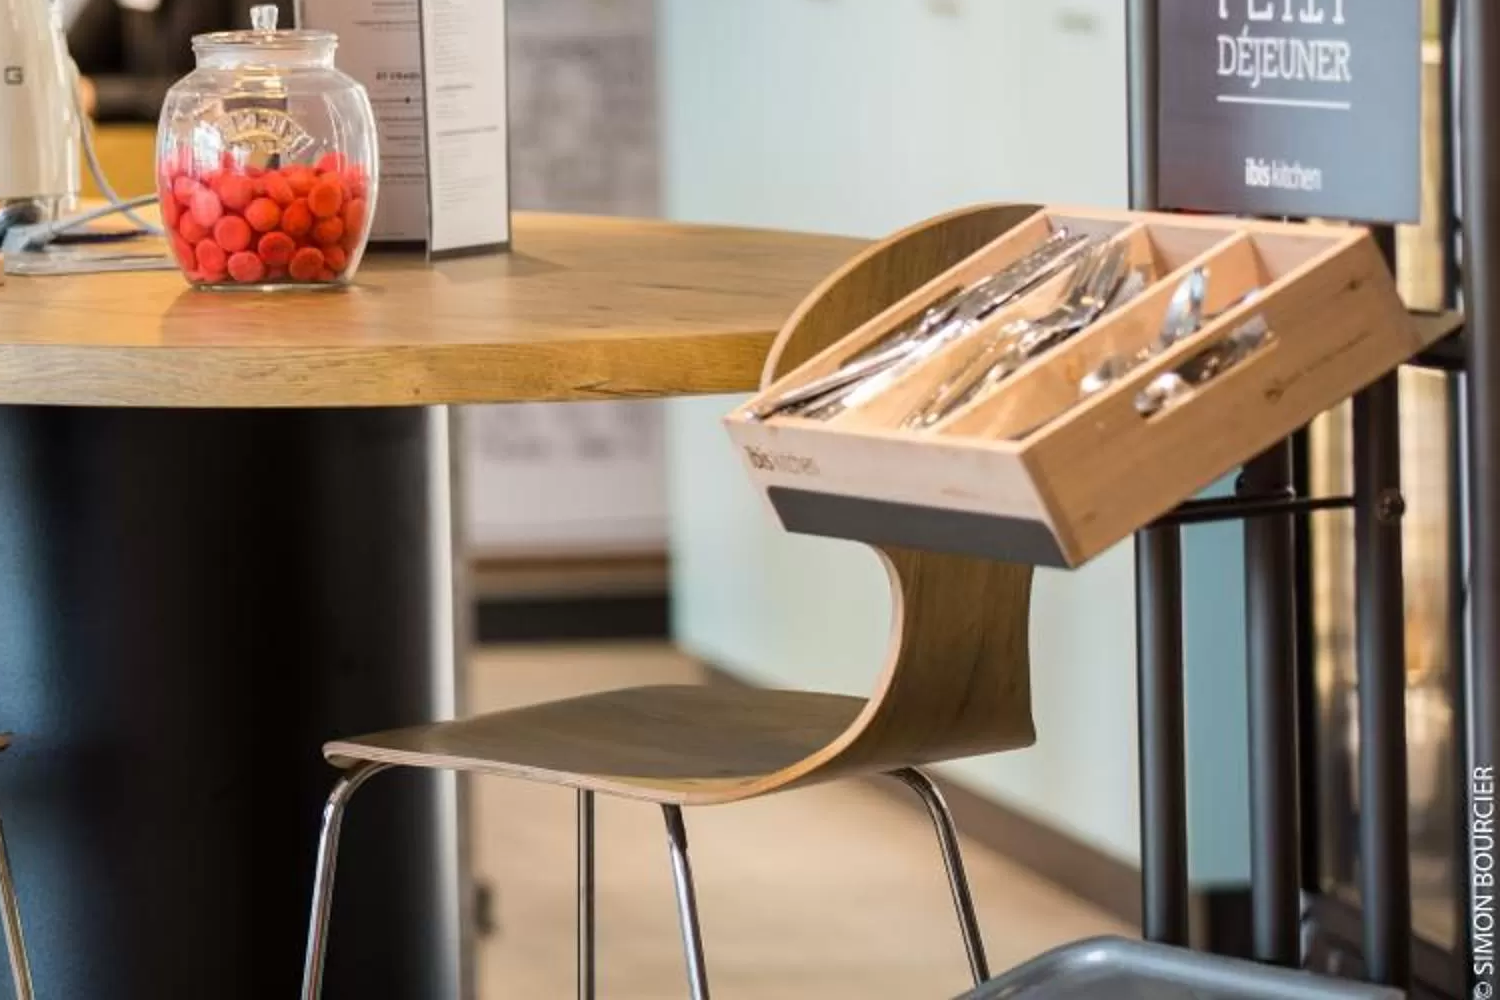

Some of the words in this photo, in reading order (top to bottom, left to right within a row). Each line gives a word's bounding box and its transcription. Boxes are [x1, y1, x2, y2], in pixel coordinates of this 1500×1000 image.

[1216, 24, 1352, 88] DÉJEUNER
[1245, 157, 1270, 187] ibis
[1271, 159, 1322, 191] kitchen
